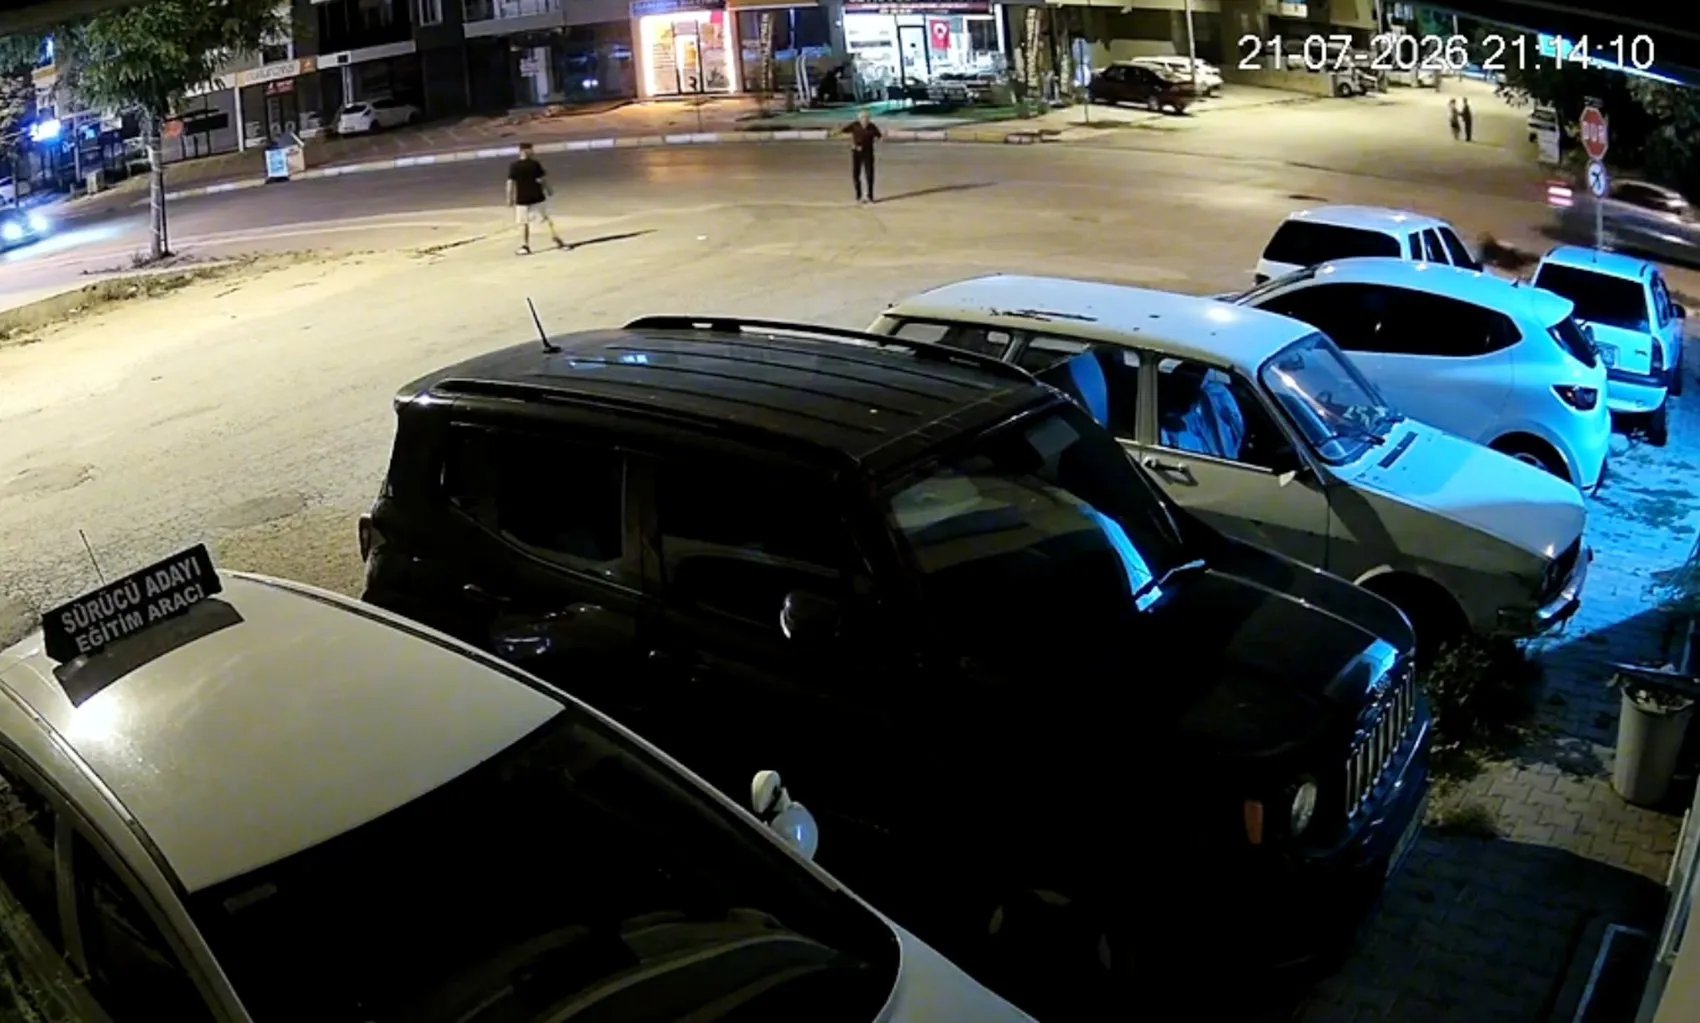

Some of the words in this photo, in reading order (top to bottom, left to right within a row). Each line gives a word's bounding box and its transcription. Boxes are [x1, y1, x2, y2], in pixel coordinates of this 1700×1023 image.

[61, 579, 141, 633] SÜRÜCÜ
[145, 556, 202, 597] ADAYI
[75, 610, 144, 652] EĞİTİM
[147, 584, 205, 622] ARACI
